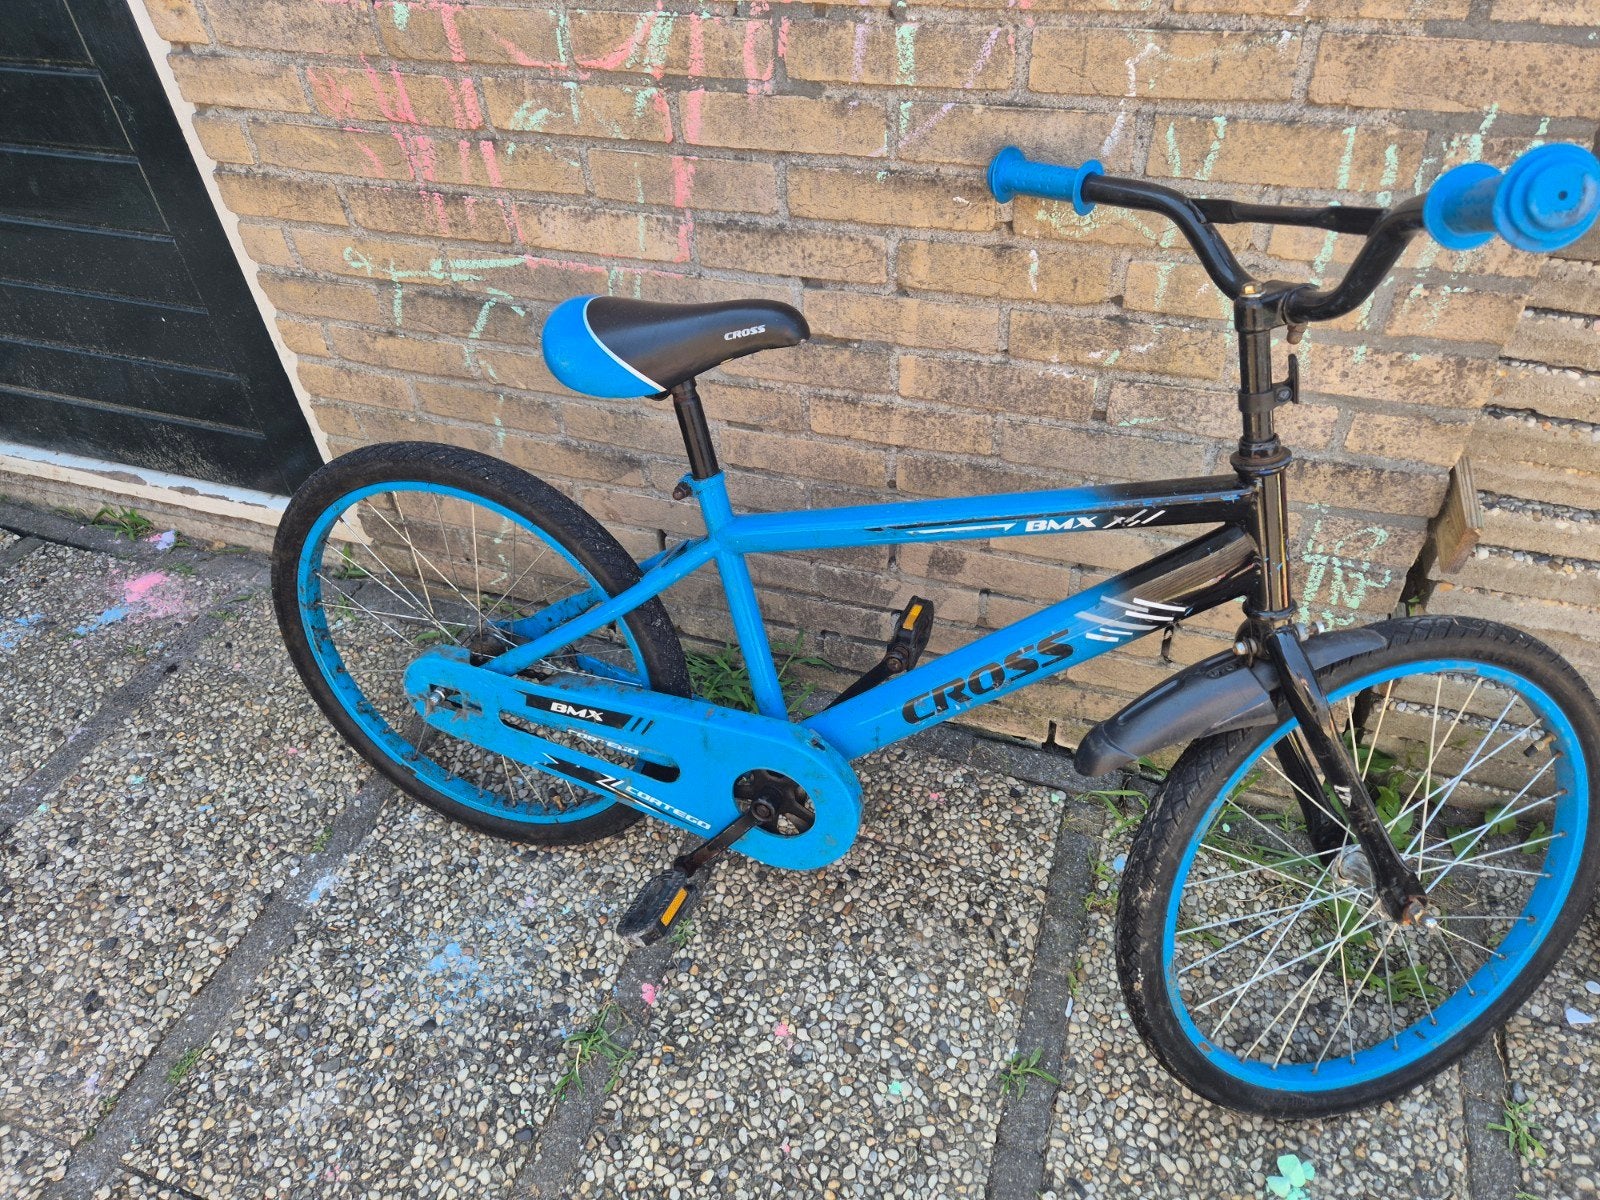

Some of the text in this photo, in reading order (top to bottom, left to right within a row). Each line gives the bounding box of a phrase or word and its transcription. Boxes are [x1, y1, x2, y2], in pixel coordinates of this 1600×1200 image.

[723, 324, 766, 341] CROSS
[1025, 516, 1098, 532] BMX
[902, 629, 1074, 725] CROSS
[550, 701, 604, 722] BMX
[625, 785, 711, 830] CORTEGO
